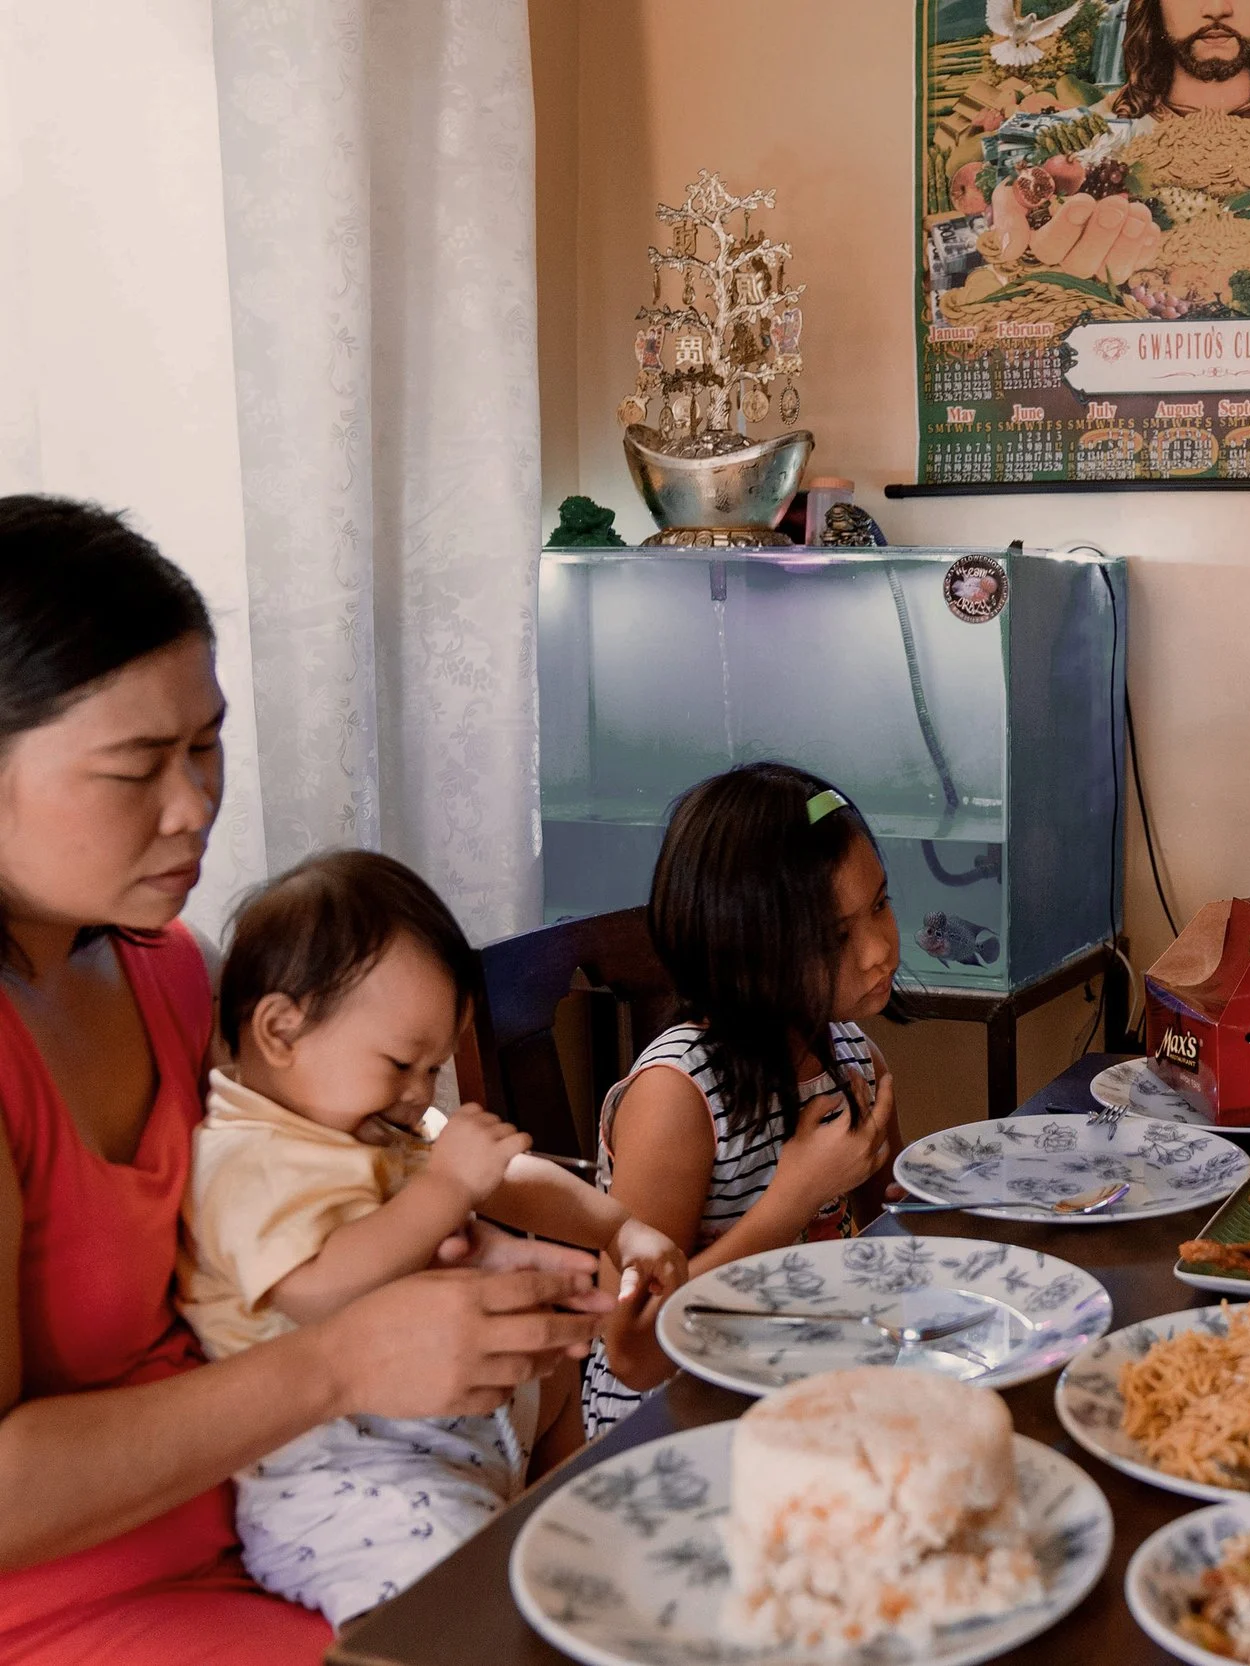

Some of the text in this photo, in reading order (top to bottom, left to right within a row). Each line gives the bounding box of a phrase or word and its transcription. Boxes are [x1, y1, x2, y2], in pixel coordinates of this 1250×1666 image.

[929, 327, 977, 342] January
[998, 322, 1054, 337] February
[1138, 326, 1224, 360] GWAPITO'S
[947, 406, 976, 422] May
[1011, 404, 1044, 422] June
[1087, 402, 1117, 419] July
[1155, 401, 1204, 418] August
[1155, 1027, 1197, 1058] Max's
